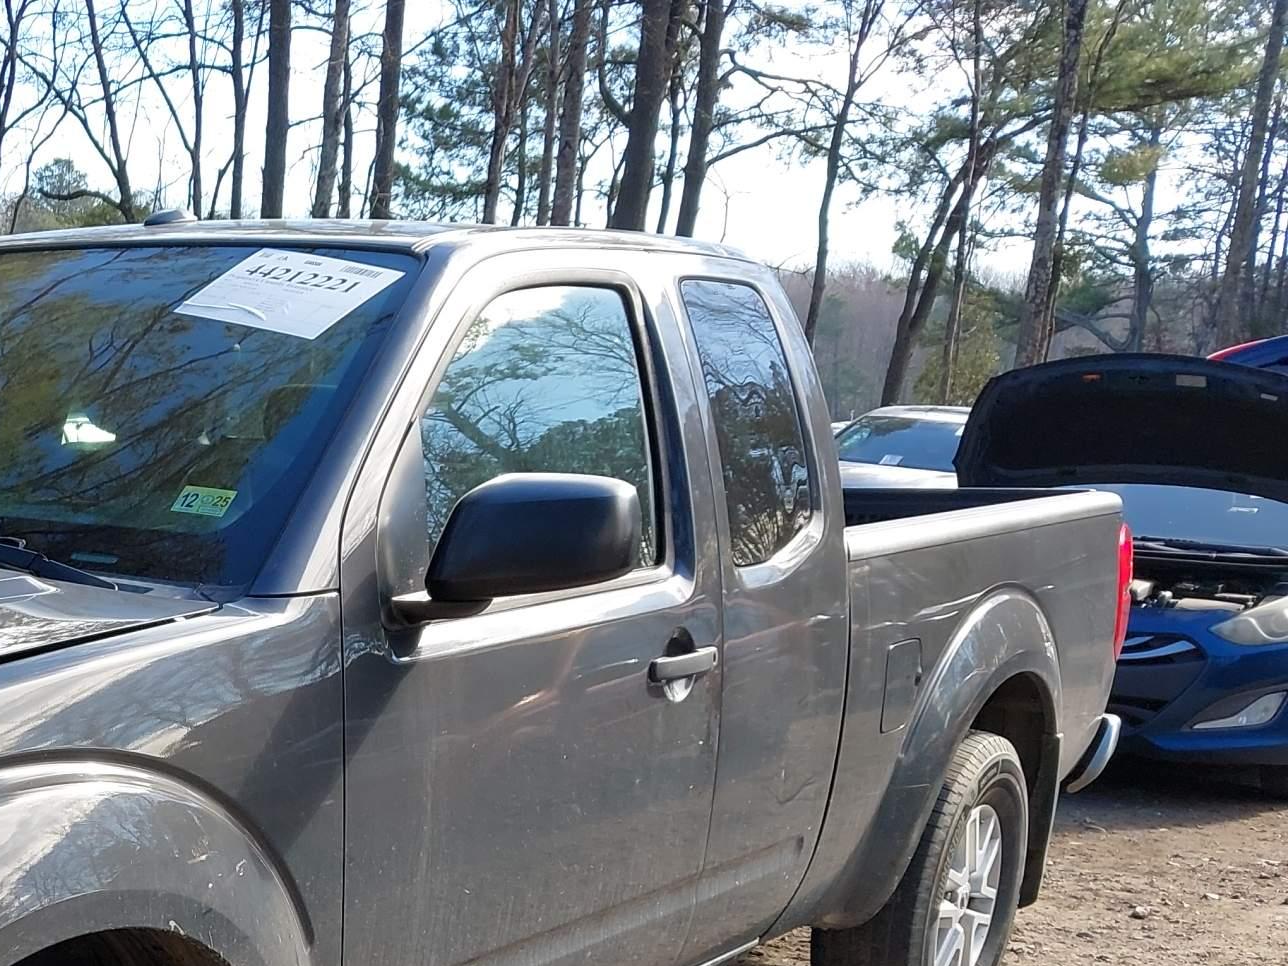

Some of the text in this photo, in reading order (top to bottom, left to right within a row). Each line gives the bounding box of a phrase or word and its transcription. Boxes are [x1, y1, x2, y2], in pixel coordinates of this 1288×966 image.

[245, 263, 361, 293] 44212221
[180, 492, 231, 508] 12 25
